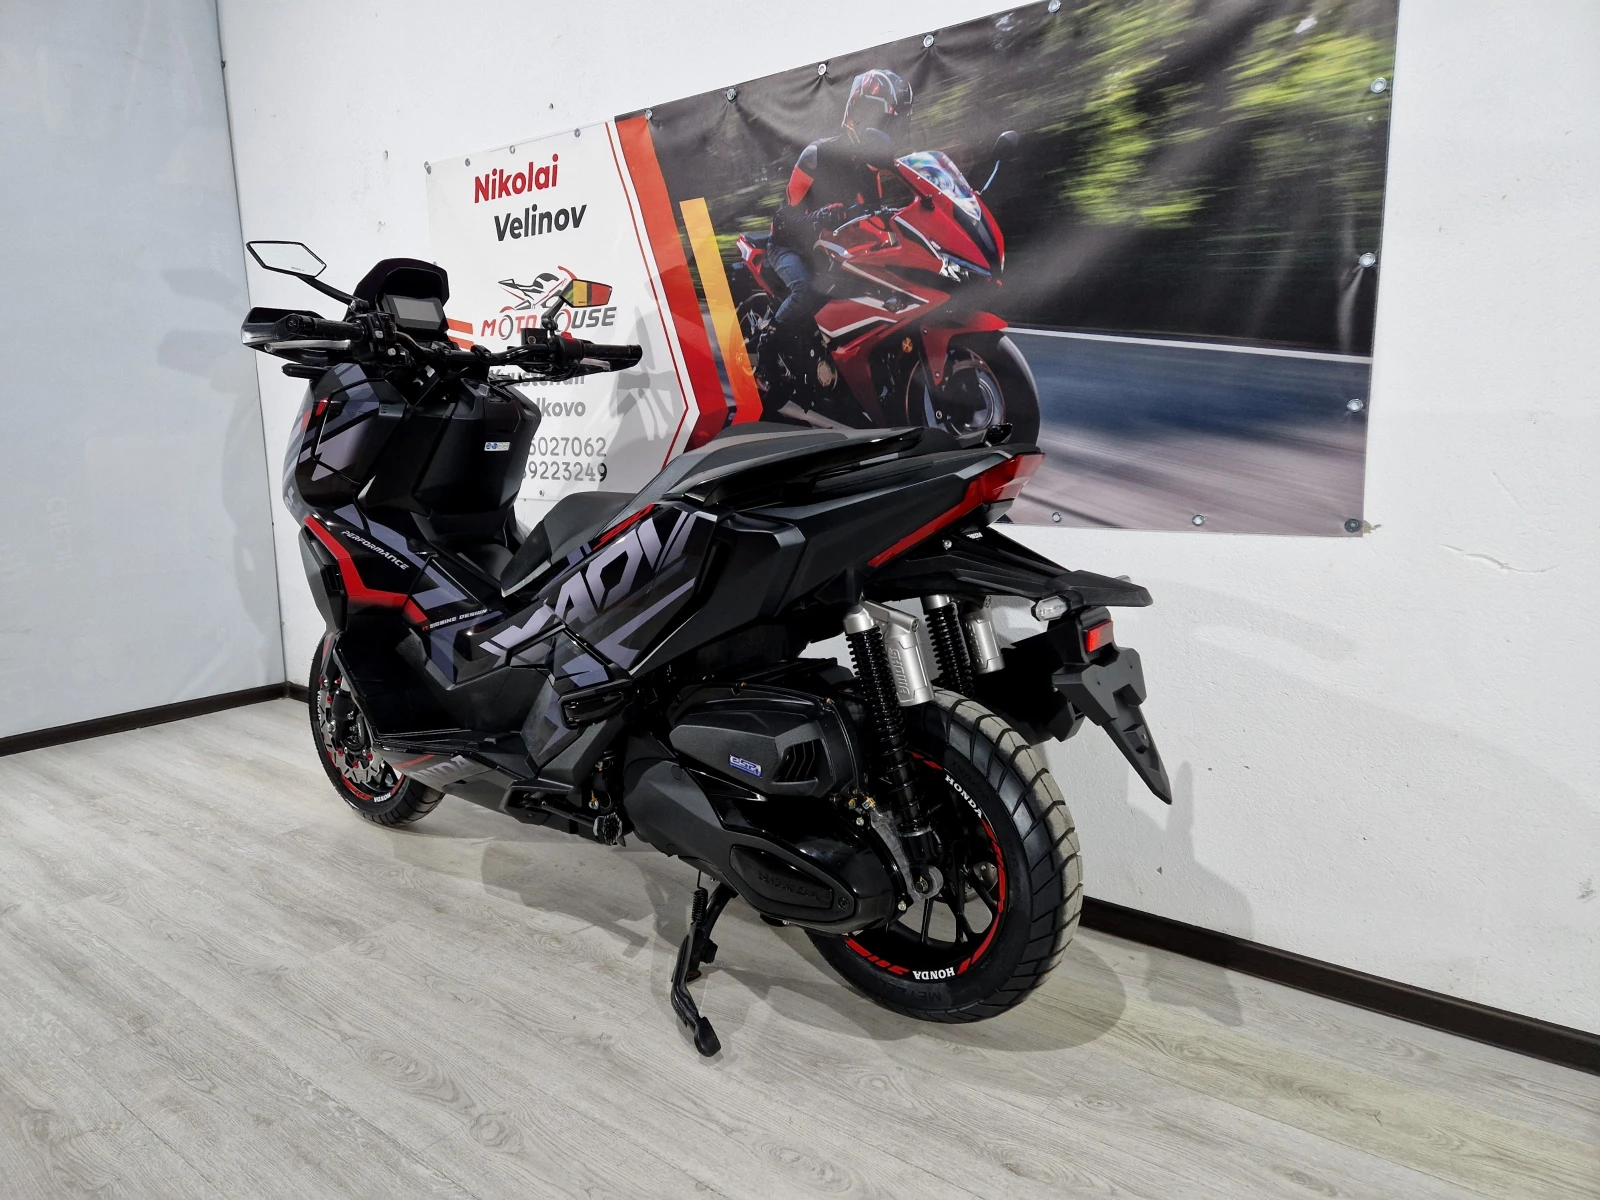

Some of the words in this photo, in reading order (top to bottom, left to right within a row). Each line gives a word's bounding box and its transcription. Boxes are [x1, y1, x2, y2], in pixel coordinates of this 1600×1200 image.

[474, 153, 559, 204] Nikolai
[494, 203, 588, 242] Velinov
[480, 306, 617, 341] MOTOOUSE
[523, 460, 608, 482] 9223249
[341, 529, 410, 571] PERFORMANCE
[944, 774, 983, 819] HONDA
[912, 966, 956, 981] HONDA
